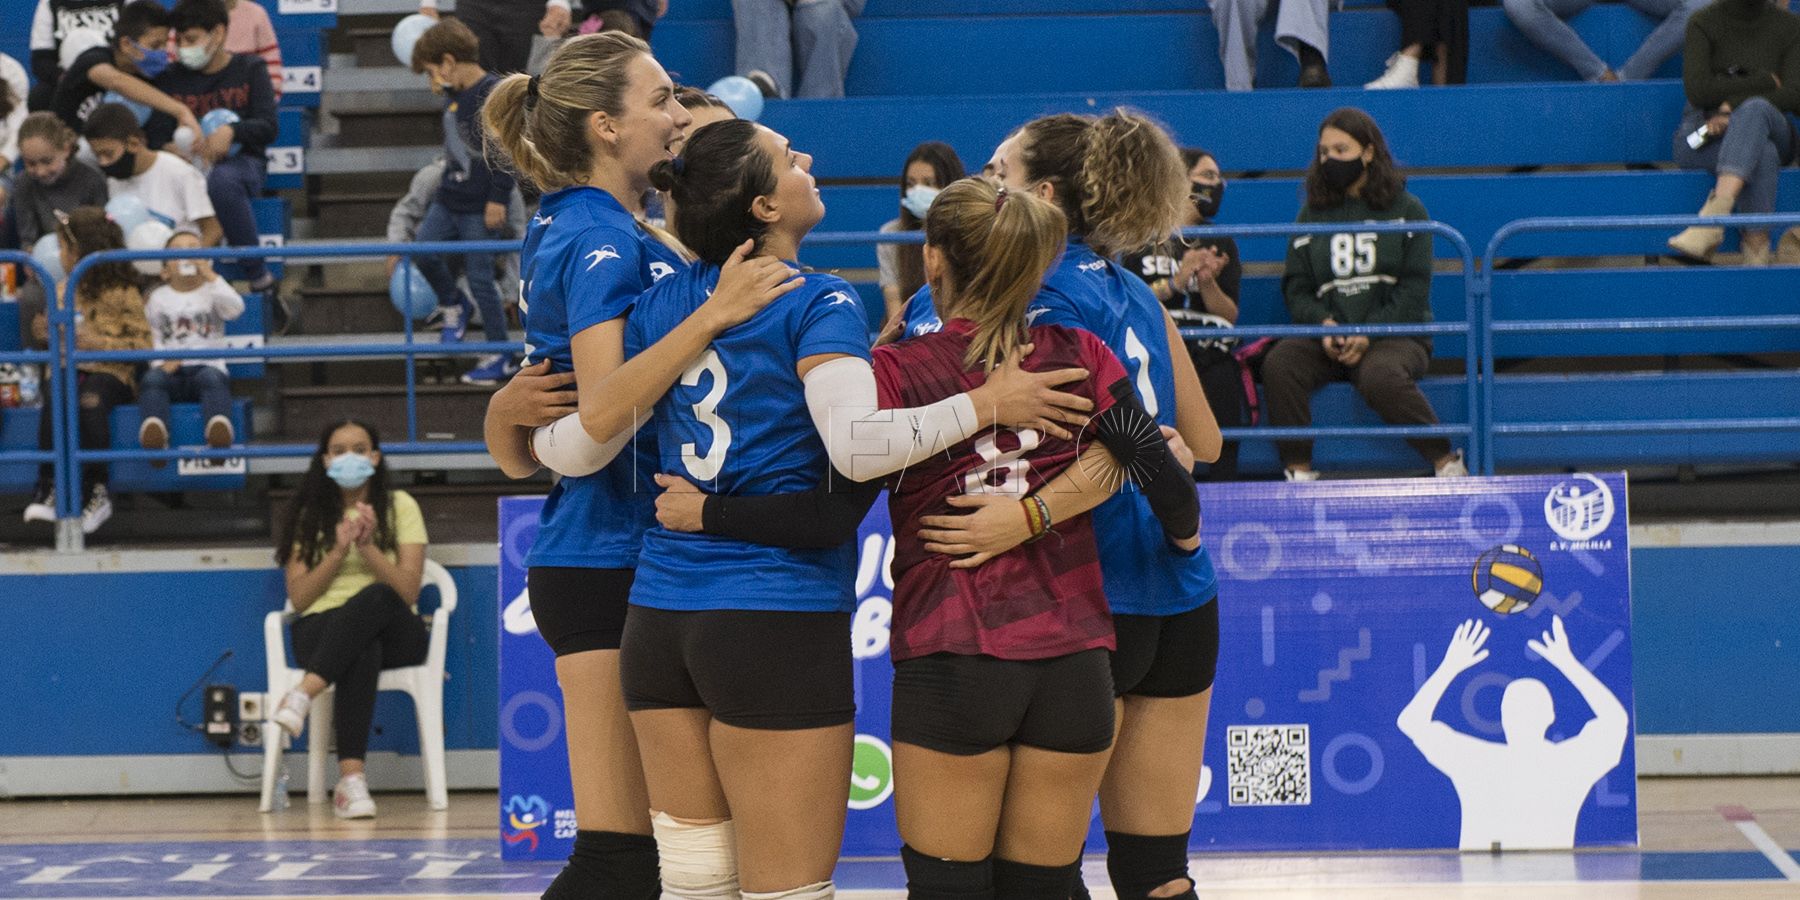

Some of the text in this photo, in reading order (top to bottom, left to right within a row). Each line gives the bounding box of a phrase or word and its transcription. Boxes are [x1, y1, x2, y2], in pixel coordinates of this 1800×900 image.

[303, 72, 316, 87] 4
[285, 152, 298, 169] 3
[1330, 232, 1378, 278] 85
[1125, 326, 1158, 419] 1
[680, 349, 732, 481] 3
